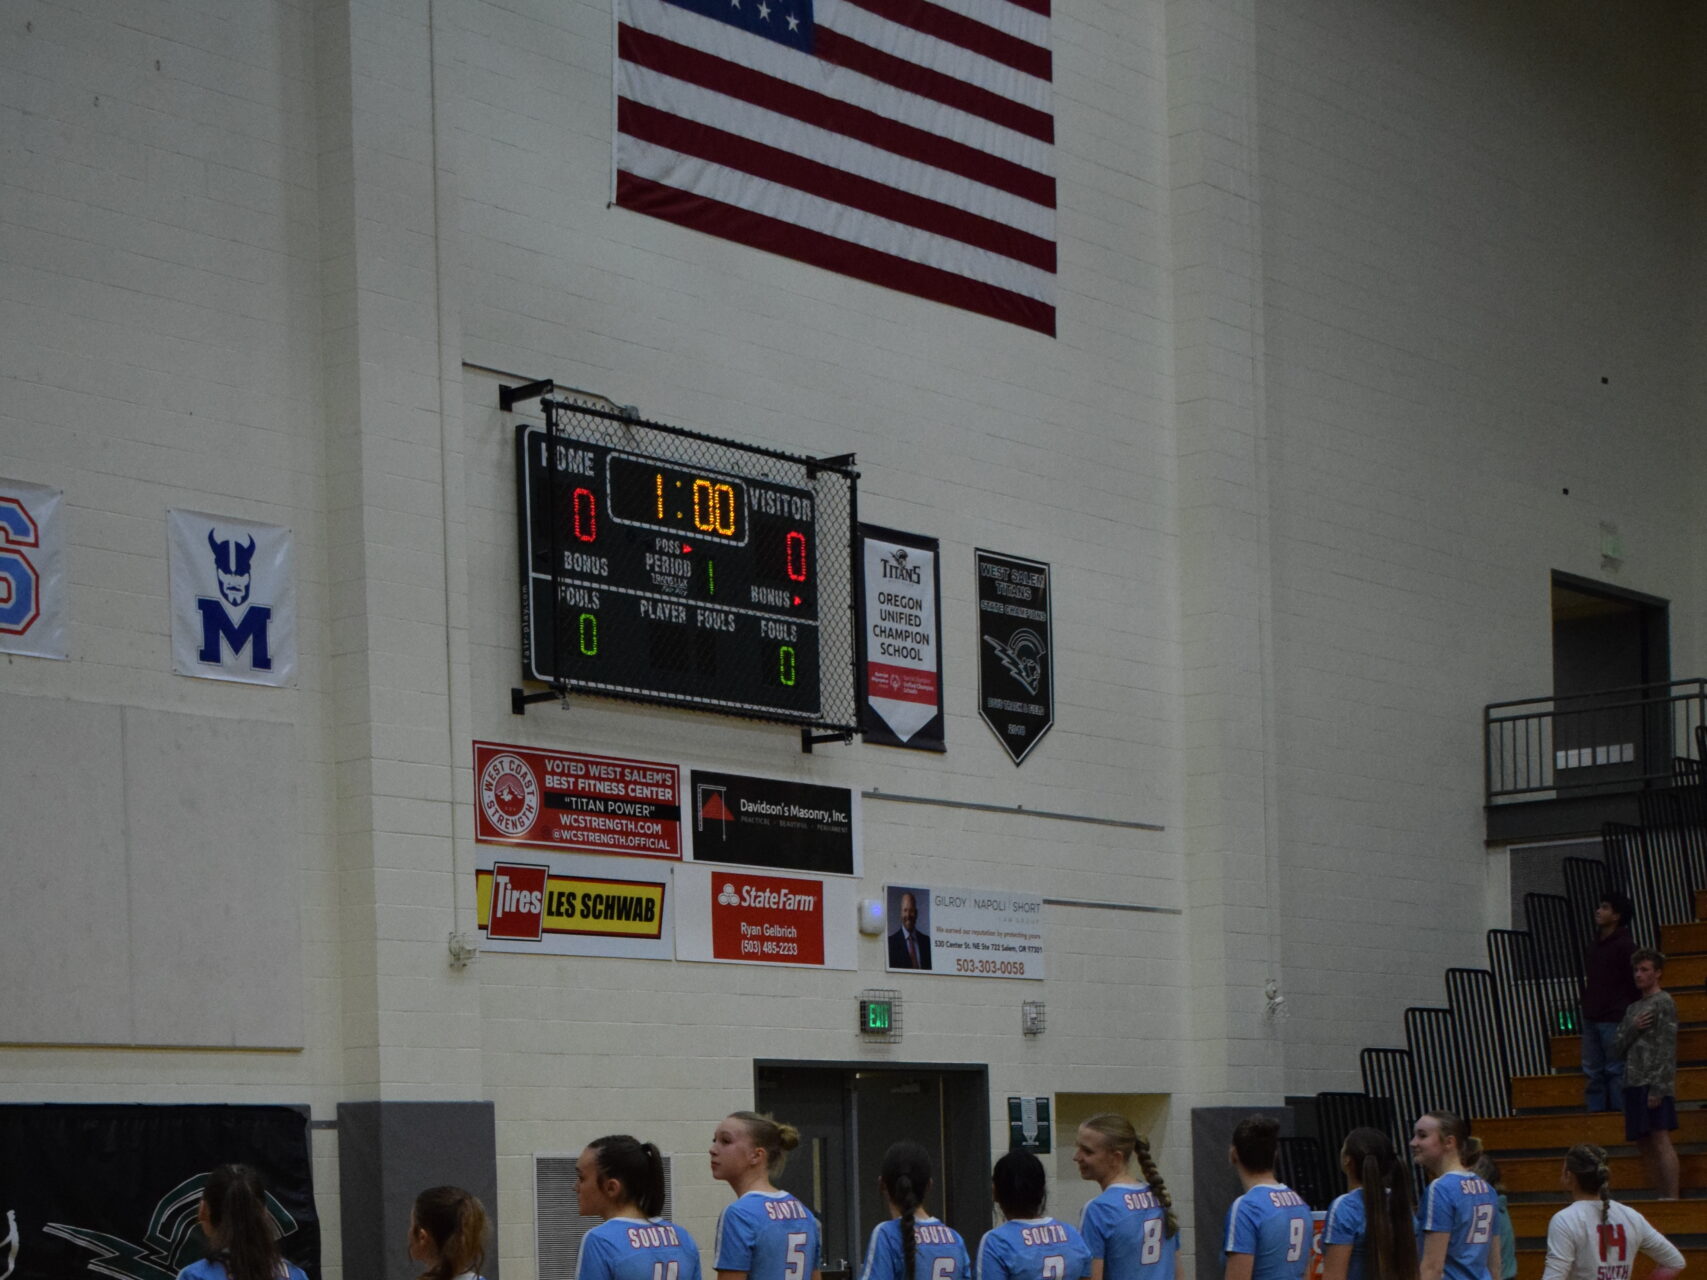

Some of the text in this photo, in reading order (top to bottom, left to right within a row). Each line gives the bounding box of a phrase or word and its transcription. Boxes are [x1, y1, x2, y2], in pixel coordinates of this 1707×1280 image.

[573, 487, 597, 543] 0
[656, 473, 736, 536] 1:00
[750, 488, 812, 522] VISITOR
[656, 537, 680, 555] POSS
[785, 530, 807, 582] 0
[564, 551, 608, 576] BONUS
[645, 553, 692, 577] PERIOD
[881, 558, 921, 585] TITANS
[980, 562, 1046, 589] WEST SALEM
[707, 560, 715, 595] 1
[558, 586, 600, 610] FOULS
[750, 585, 790, 608] BONUS
[878, 591, 922, 611] OREGON
[640, 599, 735, 631] PLAYER FOULS
[880, 609, 922, 628] UNIFIED
[198, 598, 272, 670] M
[578, 613, 598, 656] 0
[761, 619, 797, 642] FOULS
[873, 625, 930, 646] CHAMPION
[880, 643, 923, 661] SCHOOL
[779, 645, 796, 686] 0
[484, 759, 535, 797] WEST COAST
[545, 759, 672, 785] VOTED WEST SALEM'S
[545, 775, 673, 801] BEST FITNESS CENTER
[486, 800, 535, 832] STRENGTH
[740, 798, 848, 823] Davidson's Masonry, Inc.
[559, 814, 662, 835] WCSTRENGTH.COM
[552, 829, 671, 850] @WCSTRENGTH.OFFICIAL
[496, 875, 542, 919] Tires
[546, 891, 655, 923] LES SCHWAB
[935, 895, 1041, 914] GILROY NAPOLI SHORT
[741, 922, 797, 939] Ryan Gelbrich
[741, 939, 798, 956] (503) 485-2233
[956, 959, 1025, 975] 503-303-0058
[764, 1199, 807, 1221] SOUTH
[1021, 1225, 1068, 1246] SOUTH
[1464, 1203, 1494, 1244] 13
[627, 1226, 681, 1249] SOUTH
[1140, 1218, 1163, 1265] 8
[1286, 1217, 1305, 1262] 9
[1596, 1223, 1627, 1262] 14
